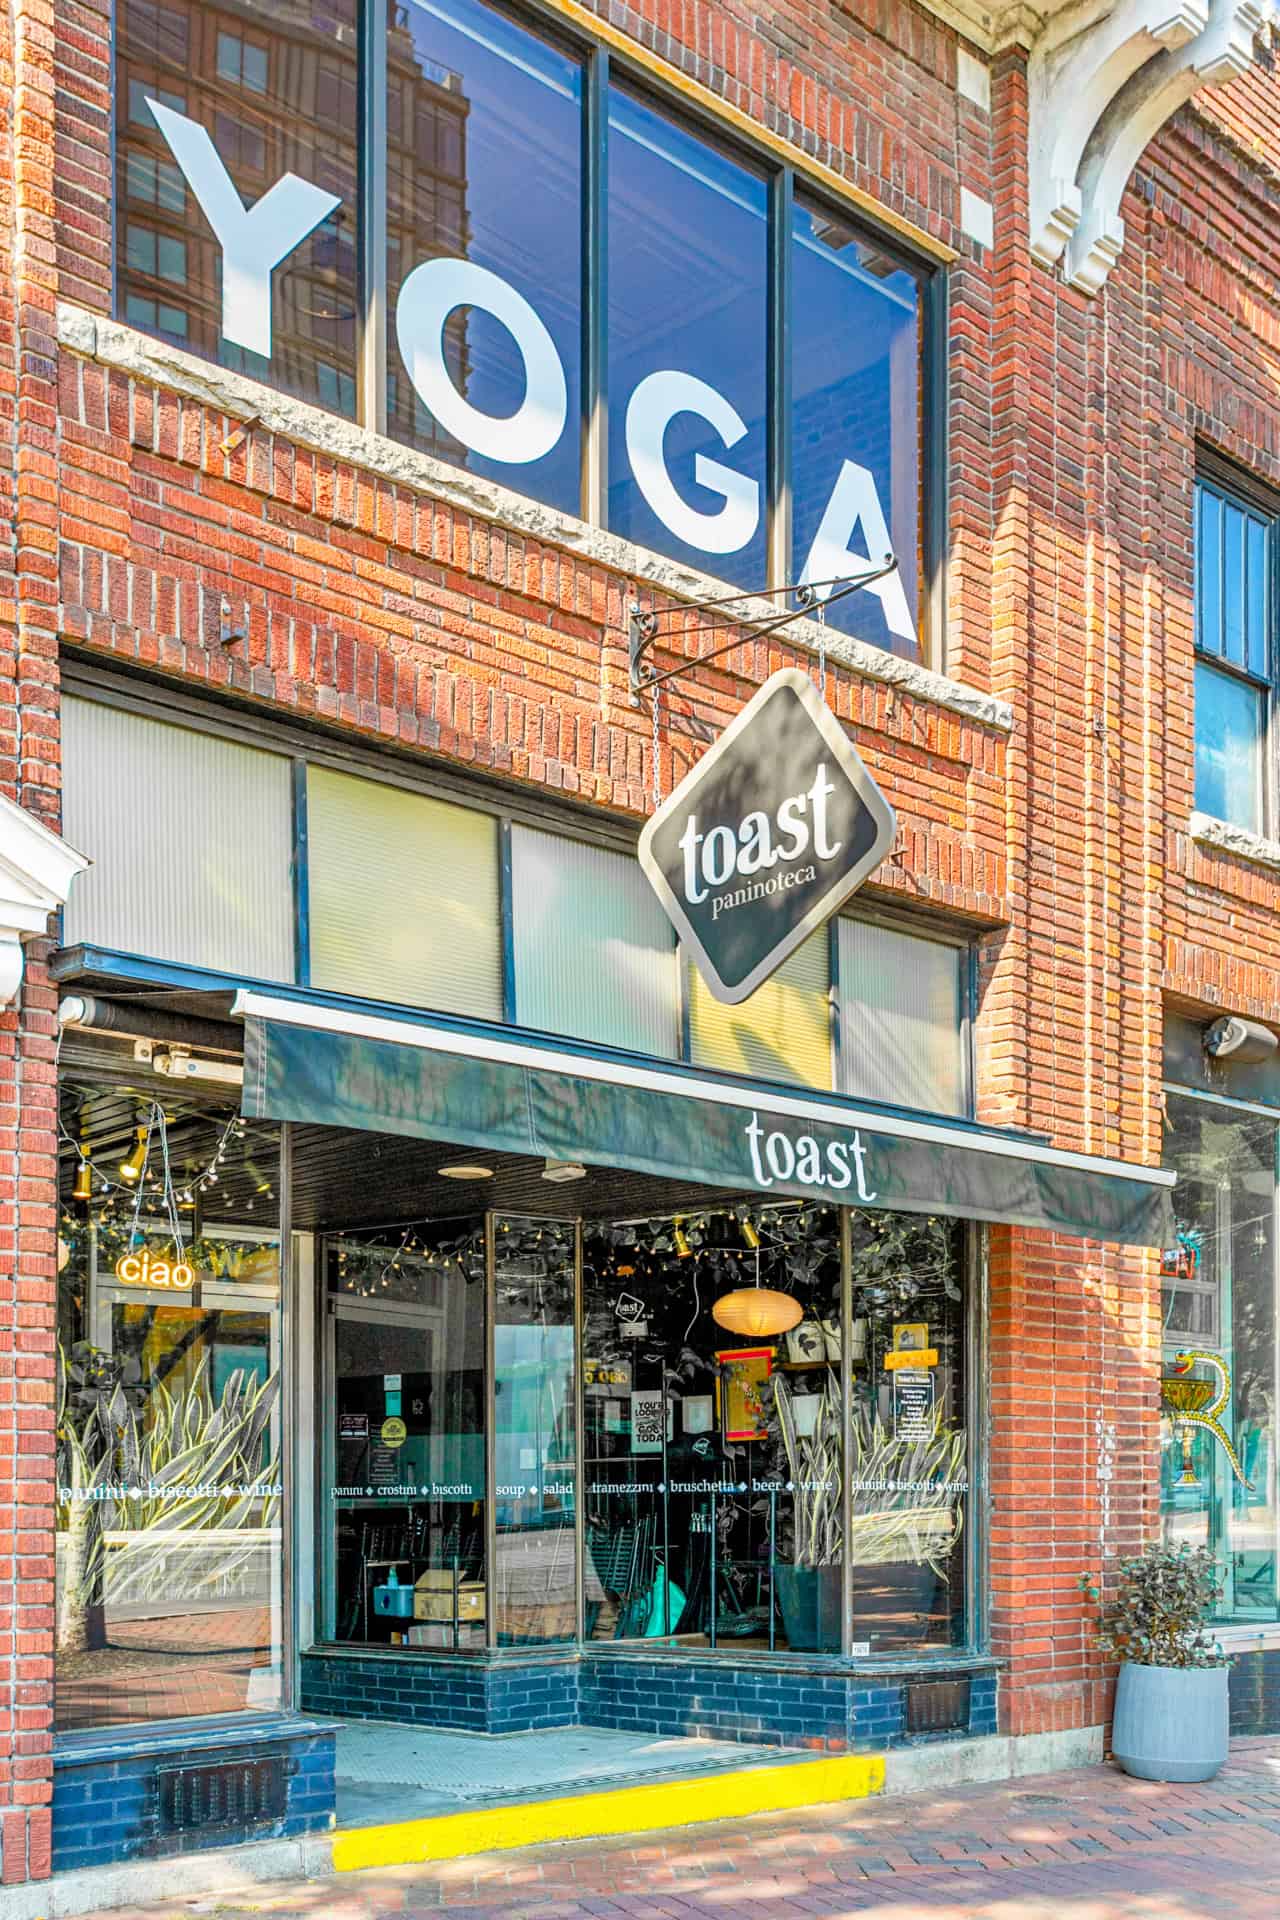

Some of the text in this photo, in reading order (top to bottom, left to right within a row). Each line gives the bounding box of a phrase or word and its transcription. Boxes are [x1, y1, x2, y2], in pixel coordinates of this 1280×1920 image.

[145, 96, 917, 643] YOGA
[679, 763, 842, 904] toast
[711, 865, 816, 920] paninoteca
[745, 1111, 877, 1201] toast
[120, 1252, 193, 1287] ciao
[60, 1481, 283, 1506] panini biscotti wine
[331, 1482, 472, 1499] panini crostini biscotti
[495, 1481, 574, 1498] soup salad
[592, 1478, 832, 1493] tramezzini bruschetta beer wine
[852, 1478, 969, 1494] panini biscotti wine
